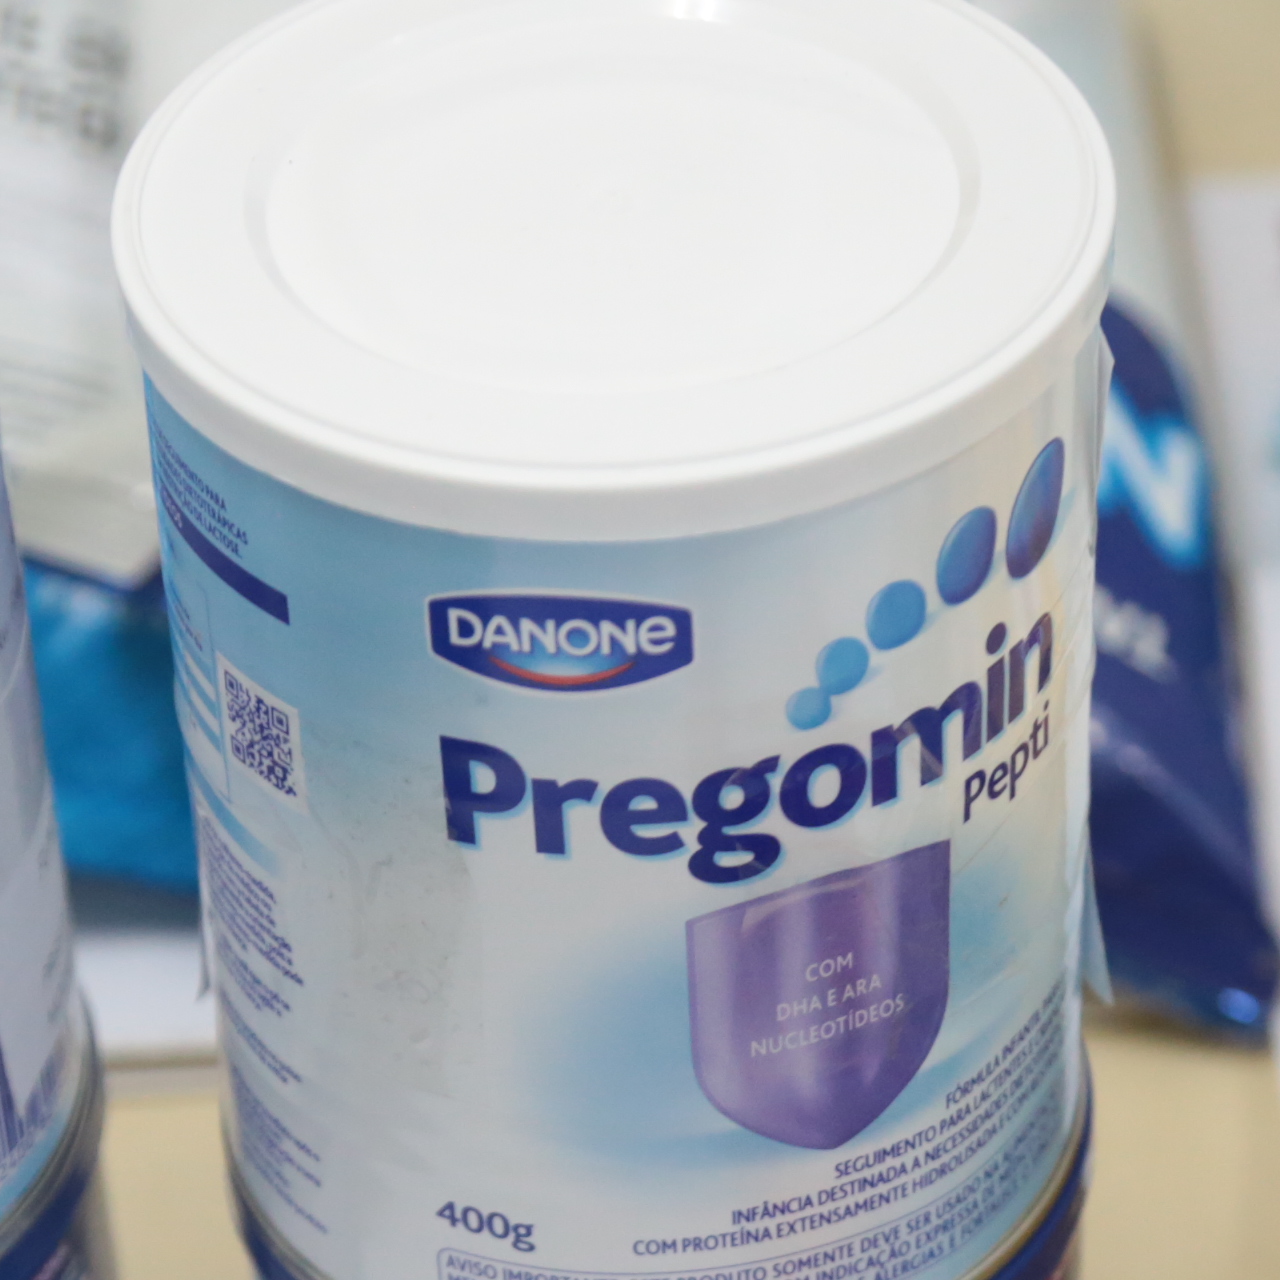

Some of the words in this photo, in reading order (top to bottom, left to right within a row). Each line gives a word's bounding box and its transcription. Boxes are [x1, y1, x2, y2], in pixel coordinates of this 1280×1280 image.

[446, 606, 678, 658] DANONE
[438, 610, 1055, 886] Pregomin
[961, 699, 1052, 825] Pepti
[775, 995, 823, 1023] DHA
[826, 988, 837, 1008] E
[841, 973, 883, 1004] ARA
[804, 951, 855, 983] COM
[749, 992, 906, 1059] NUCLEOTÍDEOS
[944, 1055, 1001, 1110] FÓRMULA
[833, 1124, 938, 1180] SEGUIMENTO
[939, 1102, 973, 1136] PARA
[632, 1238, 677, 1257] COM
[680, 1225, 773, 1254] PROTEÍNA
[775, 1185, 909, 1240] EXTENSAMENTE
[731, 1193, 814, 1226] INFÂNCIA
[816, 1161, 909, 1206] DESTINADA
[910, 1156, 925, 1174] A
[435, 1200, 537, 1253] 400g
[446, 1254, 498, 1280] AVISO
[772, 1240, 855, 1279] SOMENTE
[860, 1223, 902, 1254] DEVE
[906, 1212, 933, 1235] SER
[934, 1176, 984, 1220] USADO
[914, 1200, 980, 1250] EXPRESSA
